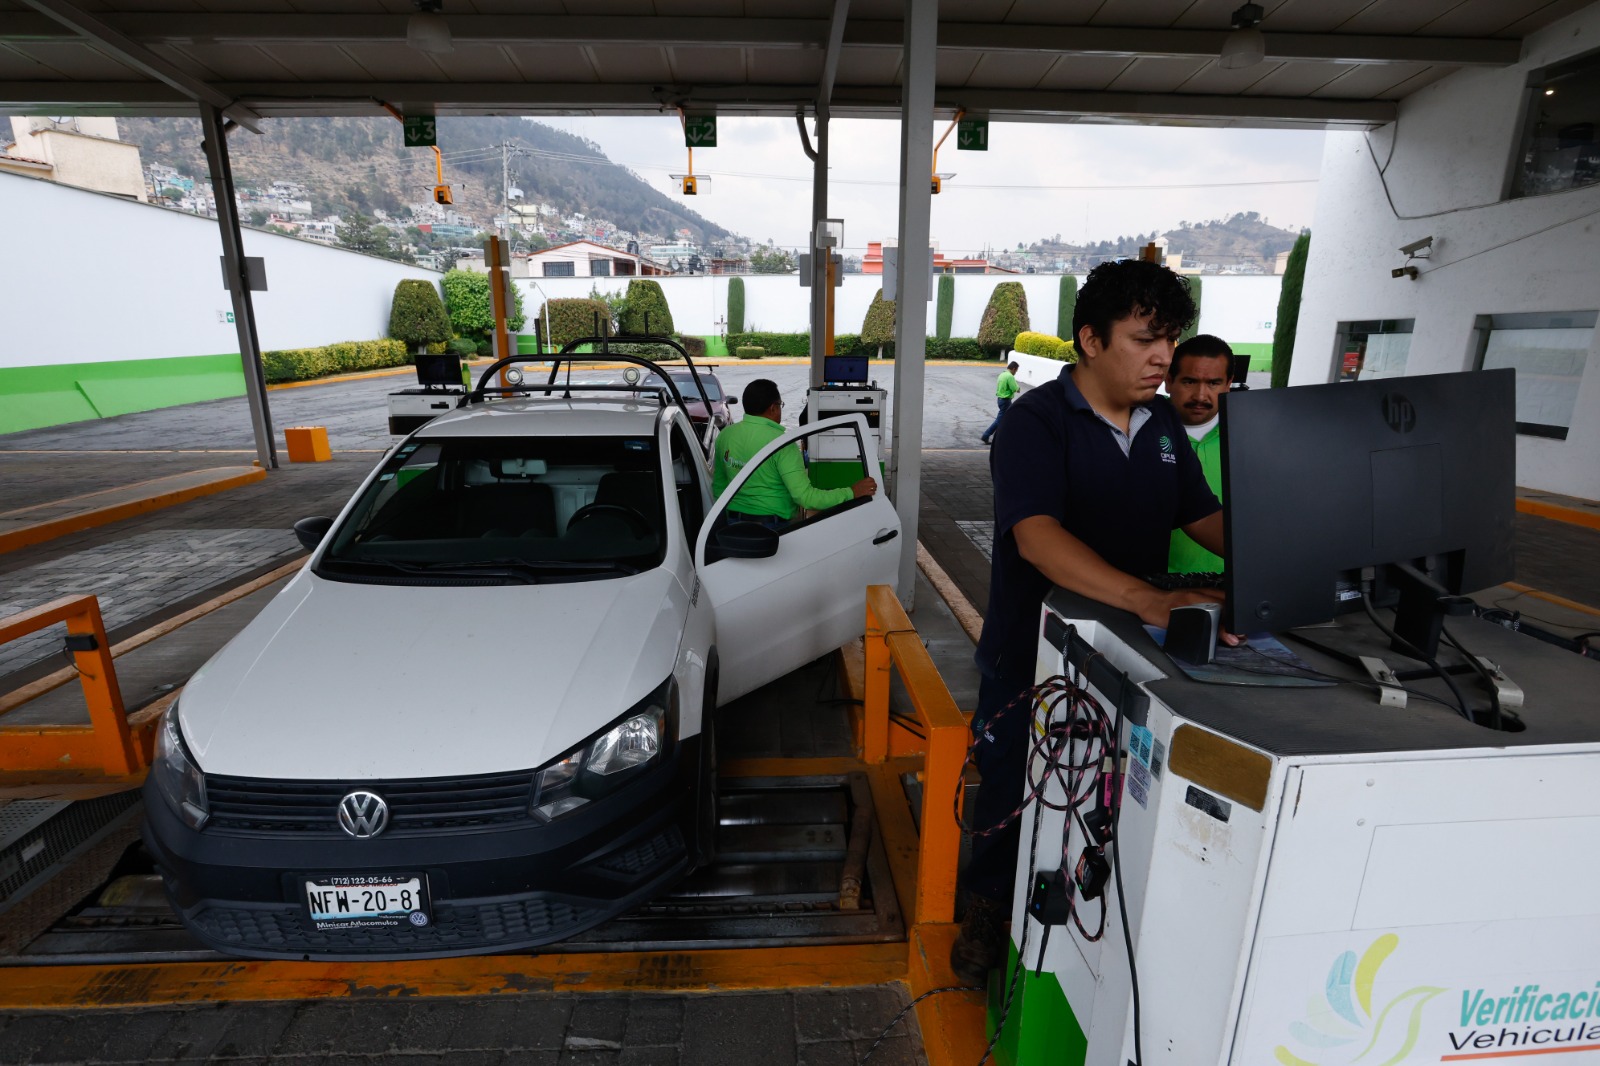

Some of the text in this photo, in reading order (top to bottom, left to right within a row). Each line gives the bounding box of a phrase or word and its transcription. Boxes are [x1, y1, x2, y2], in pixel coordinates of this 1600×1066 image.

[423, 121, 435, 139] 3
[703, 121, 715, 140] 2
[976, 127, 985, 145] 1
[1386, 393, 1413, 433] hp
[351, 876, 393, 884] 122-05-66
[1460, 981, 1600, 1027] Verificaci
